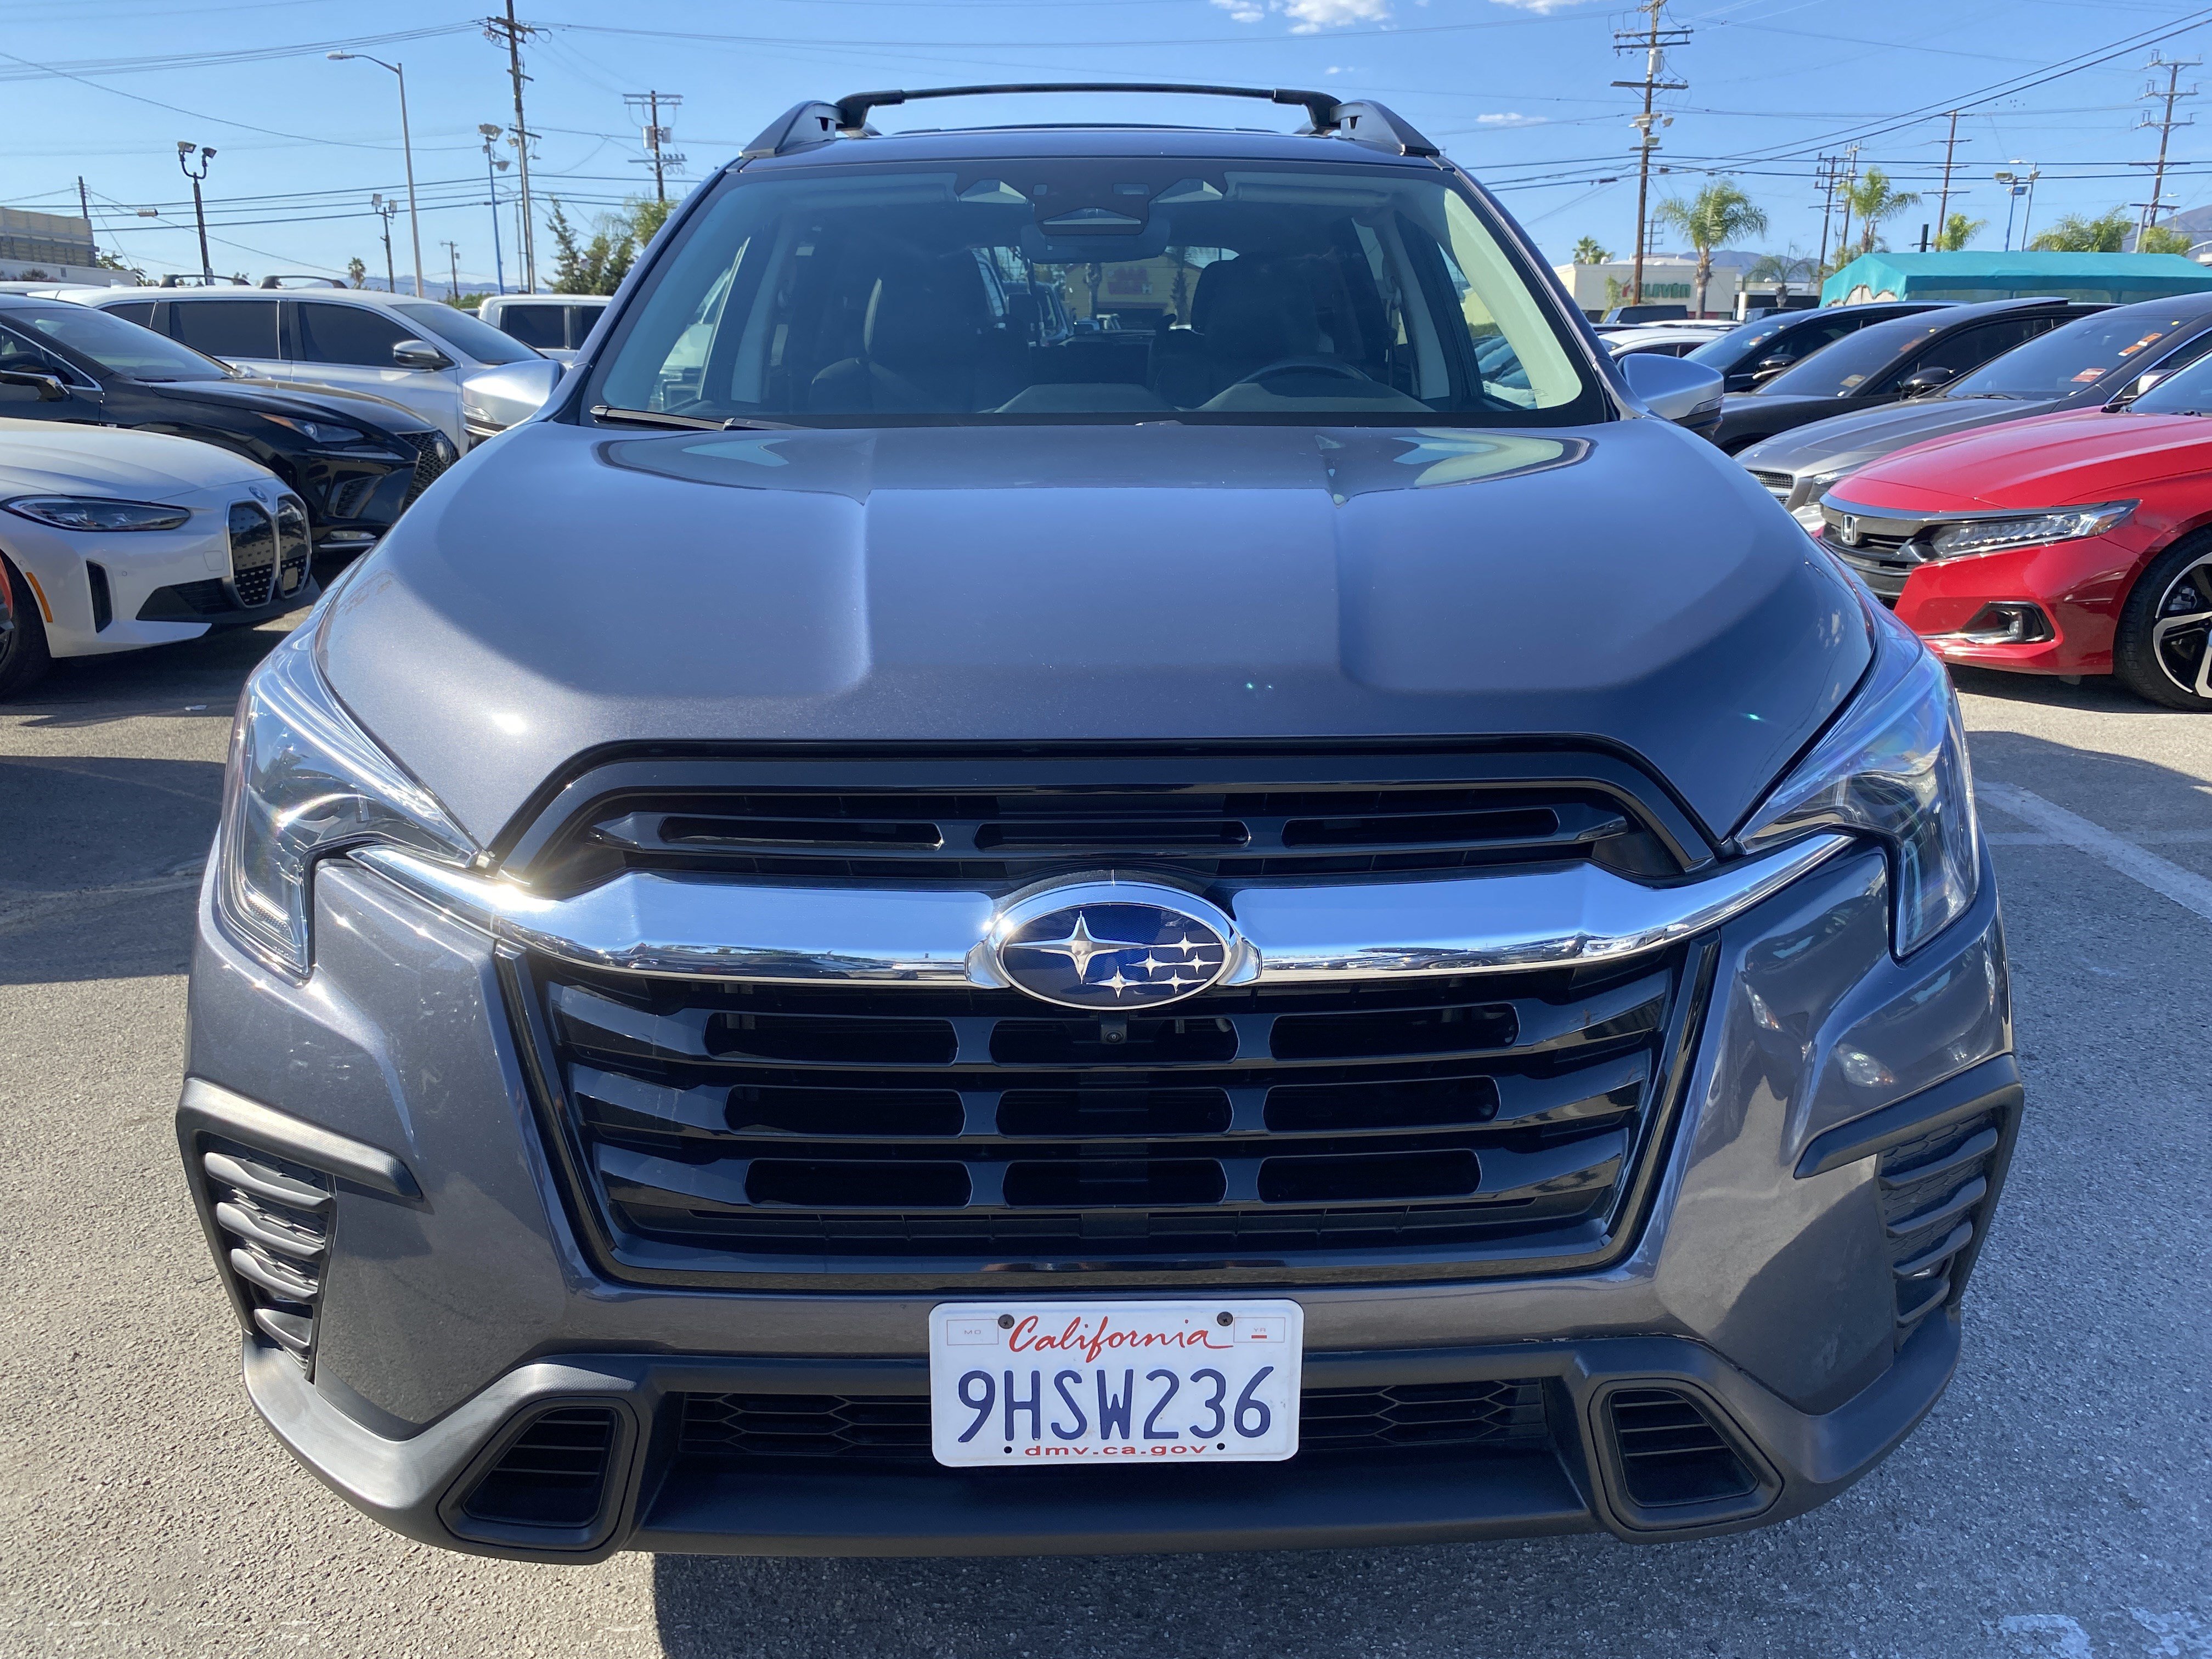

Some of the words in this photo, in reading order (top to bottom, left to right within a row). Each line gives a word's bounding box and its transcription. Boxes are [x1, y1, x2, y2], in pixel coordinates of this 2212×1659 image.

[1009, 1316, 1233, 1363] California
[957, 1366, 1274, 1443] 9HSW236
[1024, 1445, 1207, 1457] dmv.ca.gov
